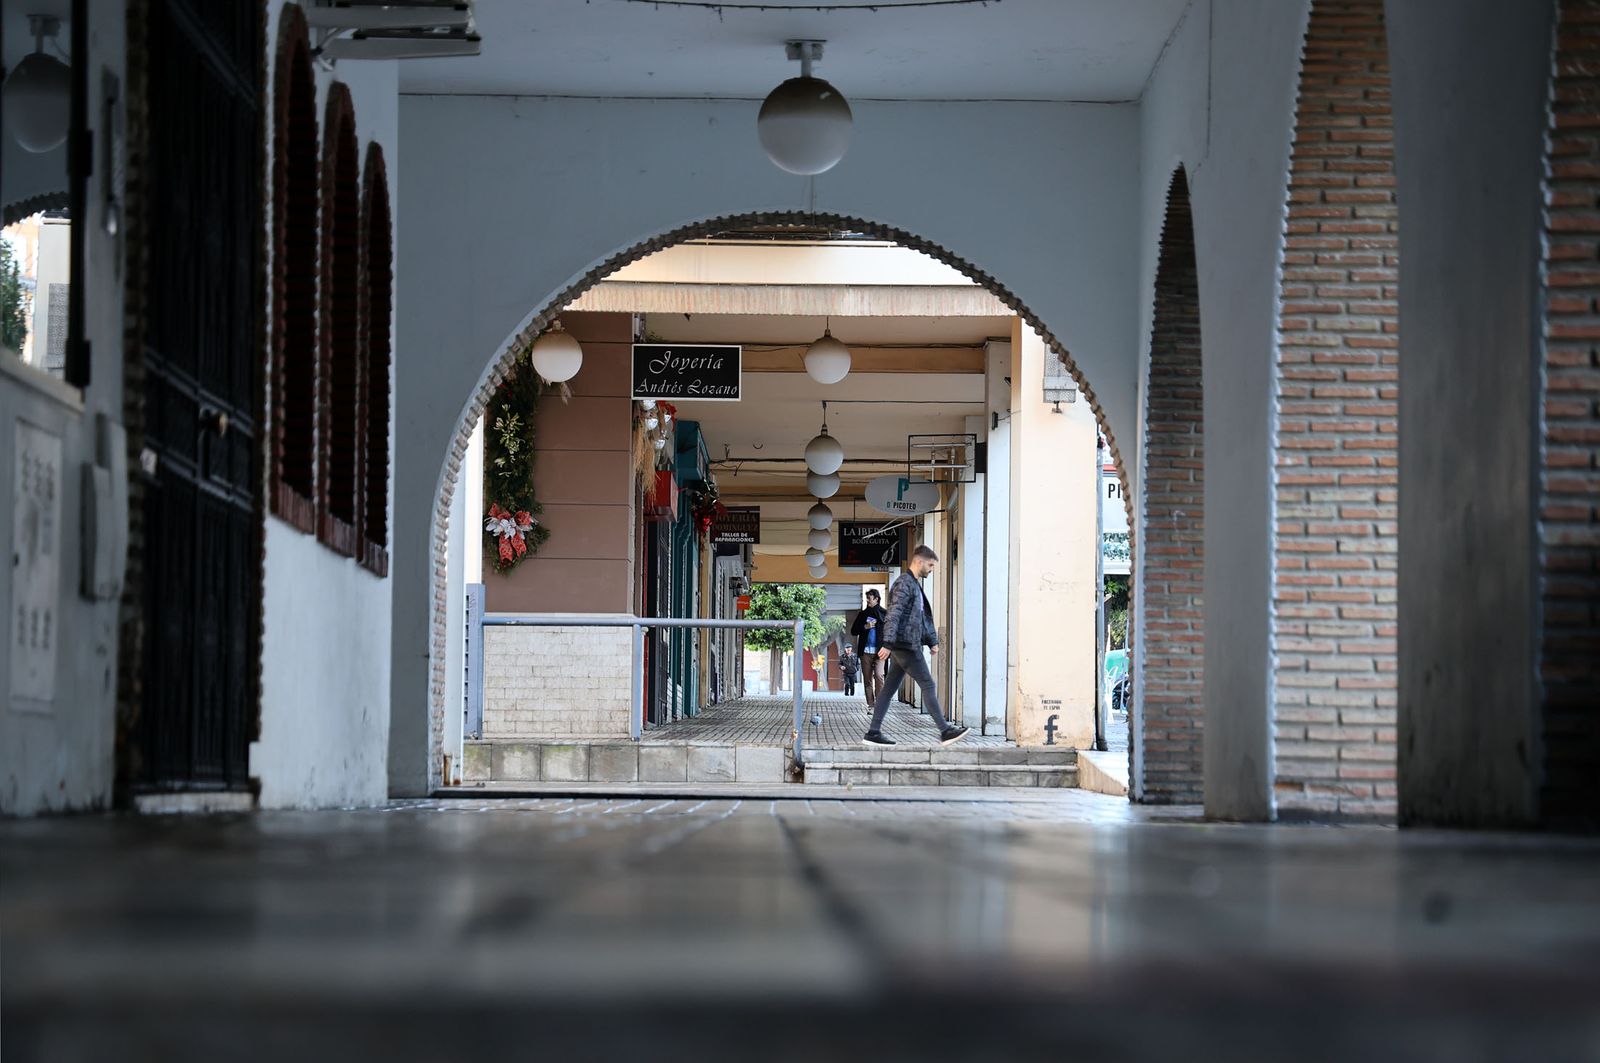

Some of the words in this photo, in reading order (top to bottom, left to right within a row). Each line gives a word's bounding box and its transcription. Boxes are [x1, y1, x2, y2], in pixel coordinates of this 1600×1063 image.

[649, 350, 723, 374] Joyería
[635, 378, 682, 394] Andrés
[687, 379, 738, 395] Lozano
[893, 502, 917, 510] PICOTEO
[843, 527, 856, 536] LA
